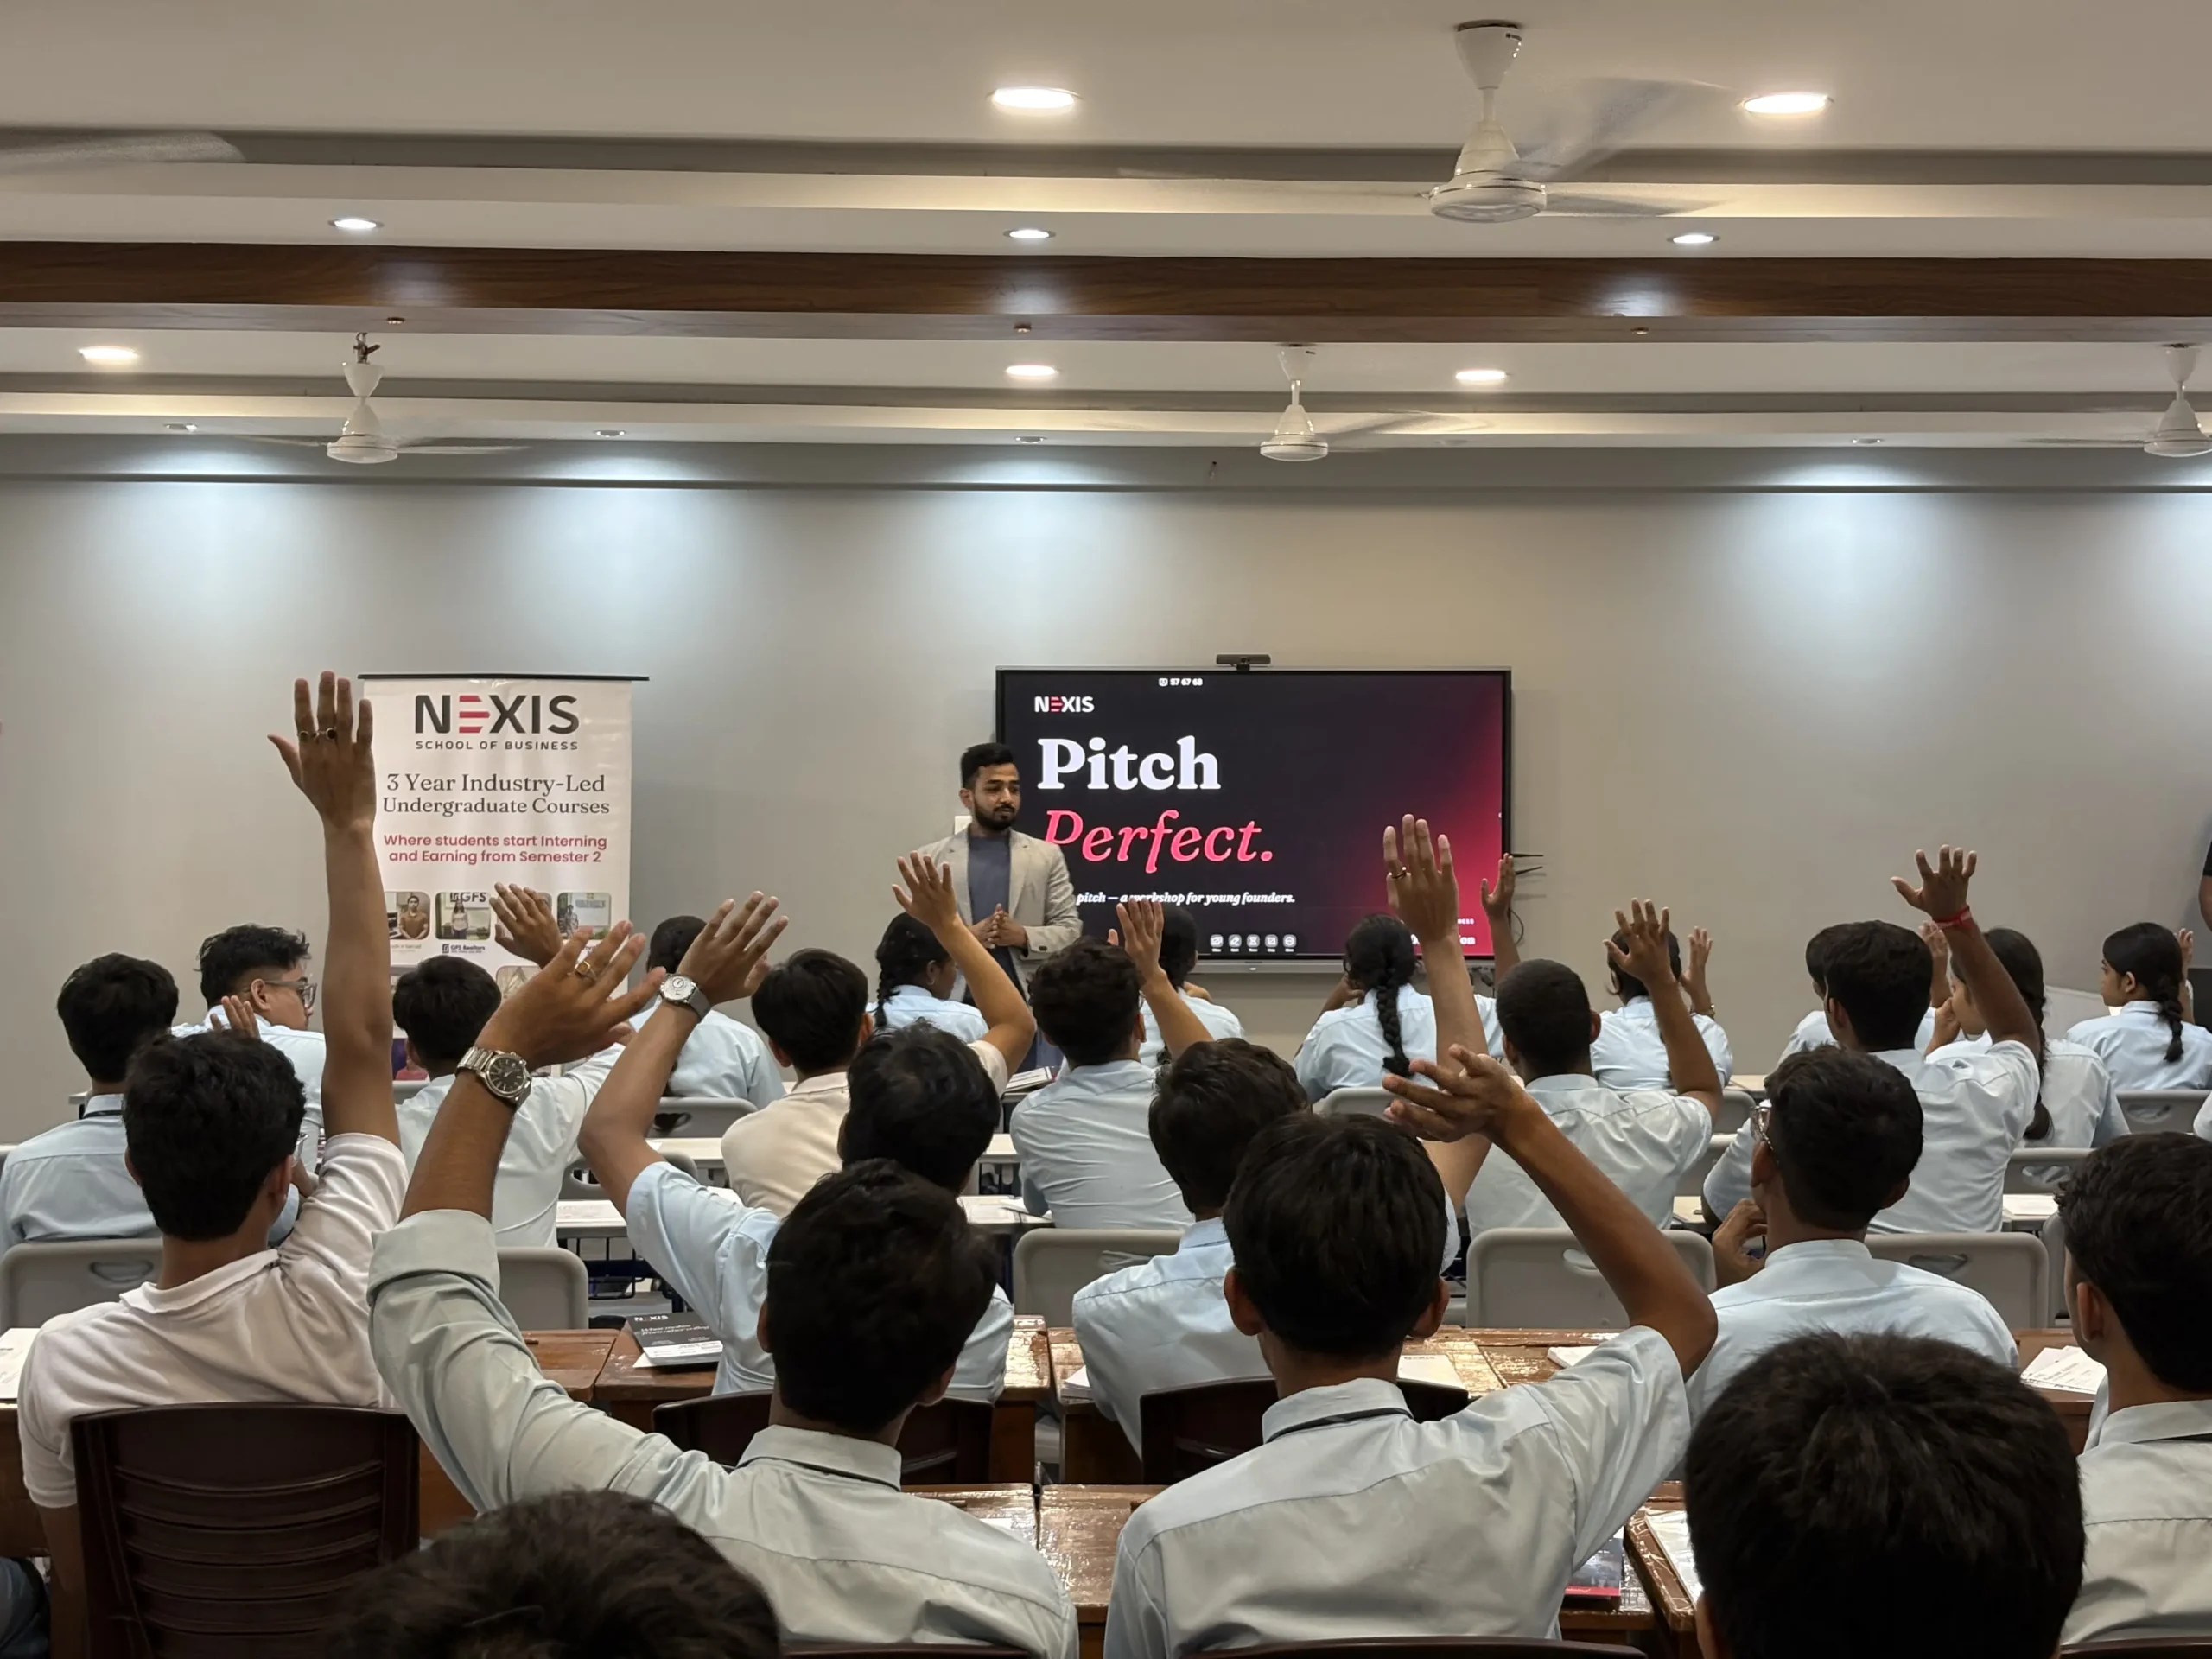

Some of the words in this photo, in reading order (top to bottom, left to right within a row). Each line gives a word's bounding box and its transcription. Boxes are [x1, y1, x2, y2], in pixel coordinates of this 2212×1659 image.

[1034, 696, 1095, 713] NEXIS
[415, 694, 580, 734] NEXIS
[416, 741, 473, 751] SCHOOL
[480, 741, 499, 751] OF
[505, 741, 579, 751] BUSINESS
[1037, 734, 1222, 791] Pitch
[386, 773, 399, 791] 3
[405, 773, 456, 792] Year
[461, 773, 606, 798] Industry-Led
[383, 796, 528, 817] Undergraduate
[531, 797, 610, 815] Courses
[384, 834, 432, 847] Where
[435, 834, 499, 848] students
[503, 835, 537, 848] start
[541, 835, 607, 850] Interning
[1043, 810, 1274, 874] Perfect.
[389, 850, 419, 862] and
[422, 850, 478, 865] Earning
[480, 850, 516, 863] from
[519, 851, 590, 863] Semester
[592, 851, 601, 863] 2
[460, 892, 487, 903] GFS
[1076, 891, 1106, 906] pitch
[1120, 894, 1128, 903] a
[1185, 892, 1204, 906] for
[1204, 894, 1241, 906] young
[1241, 891, 1296, 906] founders.
